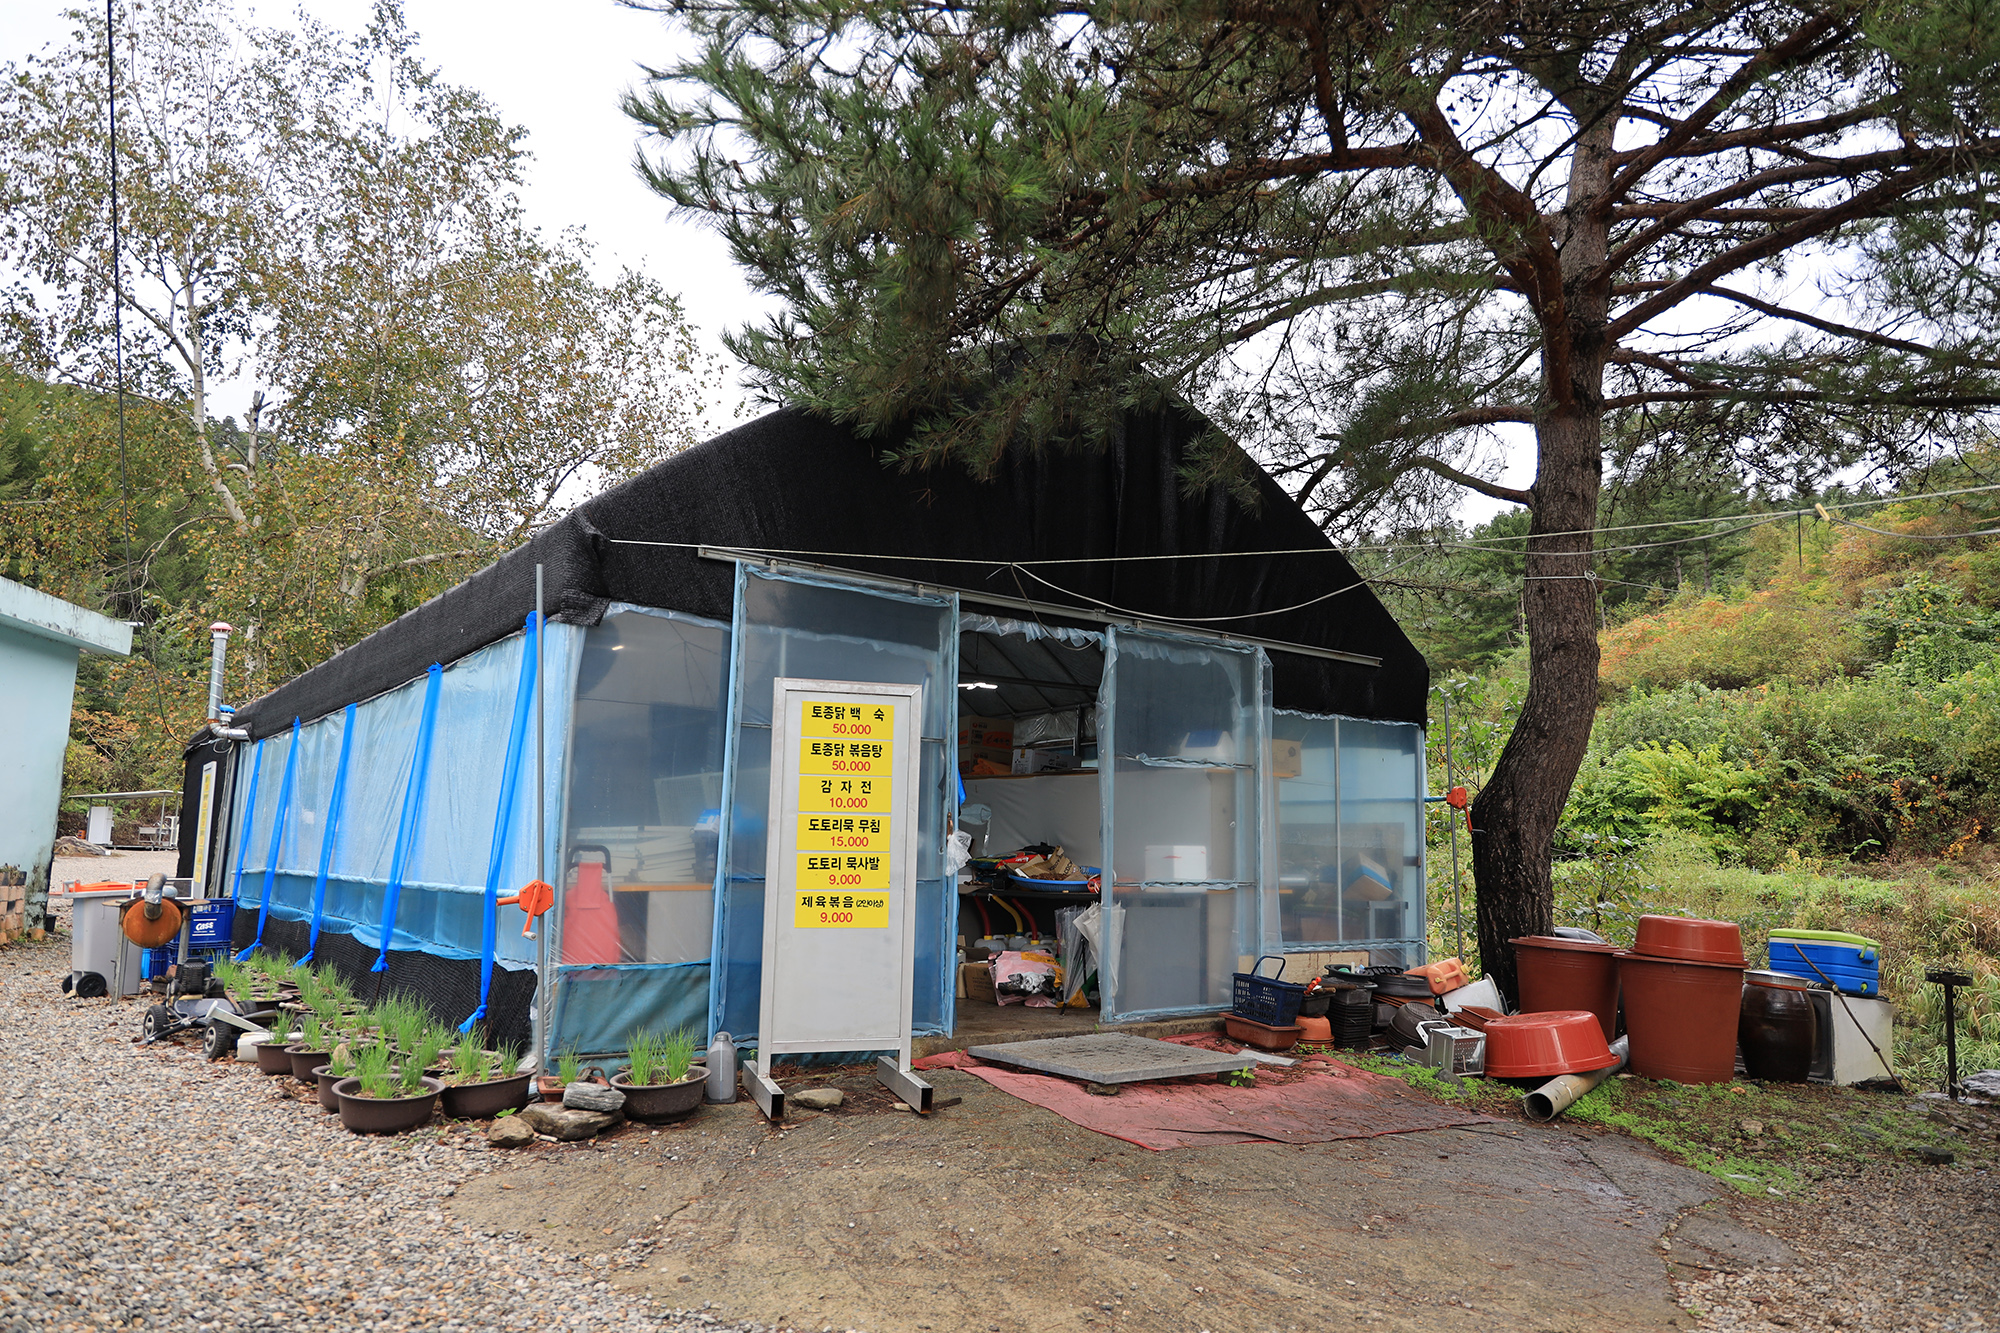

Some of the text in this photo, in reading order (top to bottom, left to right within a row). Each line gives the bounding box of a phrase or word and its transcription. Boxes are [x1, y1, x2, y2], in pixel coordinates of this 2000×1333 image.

[811, 706, 845, 719] 토종닭
[833, 723, 871, 735] 50.000
[811, 743, 883, 758] 토종닭 볶음탕
[832, 760, 871, 771] 50.000
[830, 797, 868, 808] 10.000
[808, 819, 880, 833] 도토리묵 무침
[831, 836, 869, 847] 15.000
[807, 857, 880, 870] 도토리 묵사발
[829, 874, 861, 885] 9.000
[802, 896, 854, 908] 제육볶음
[820, 912, 853, 923] 9.000
